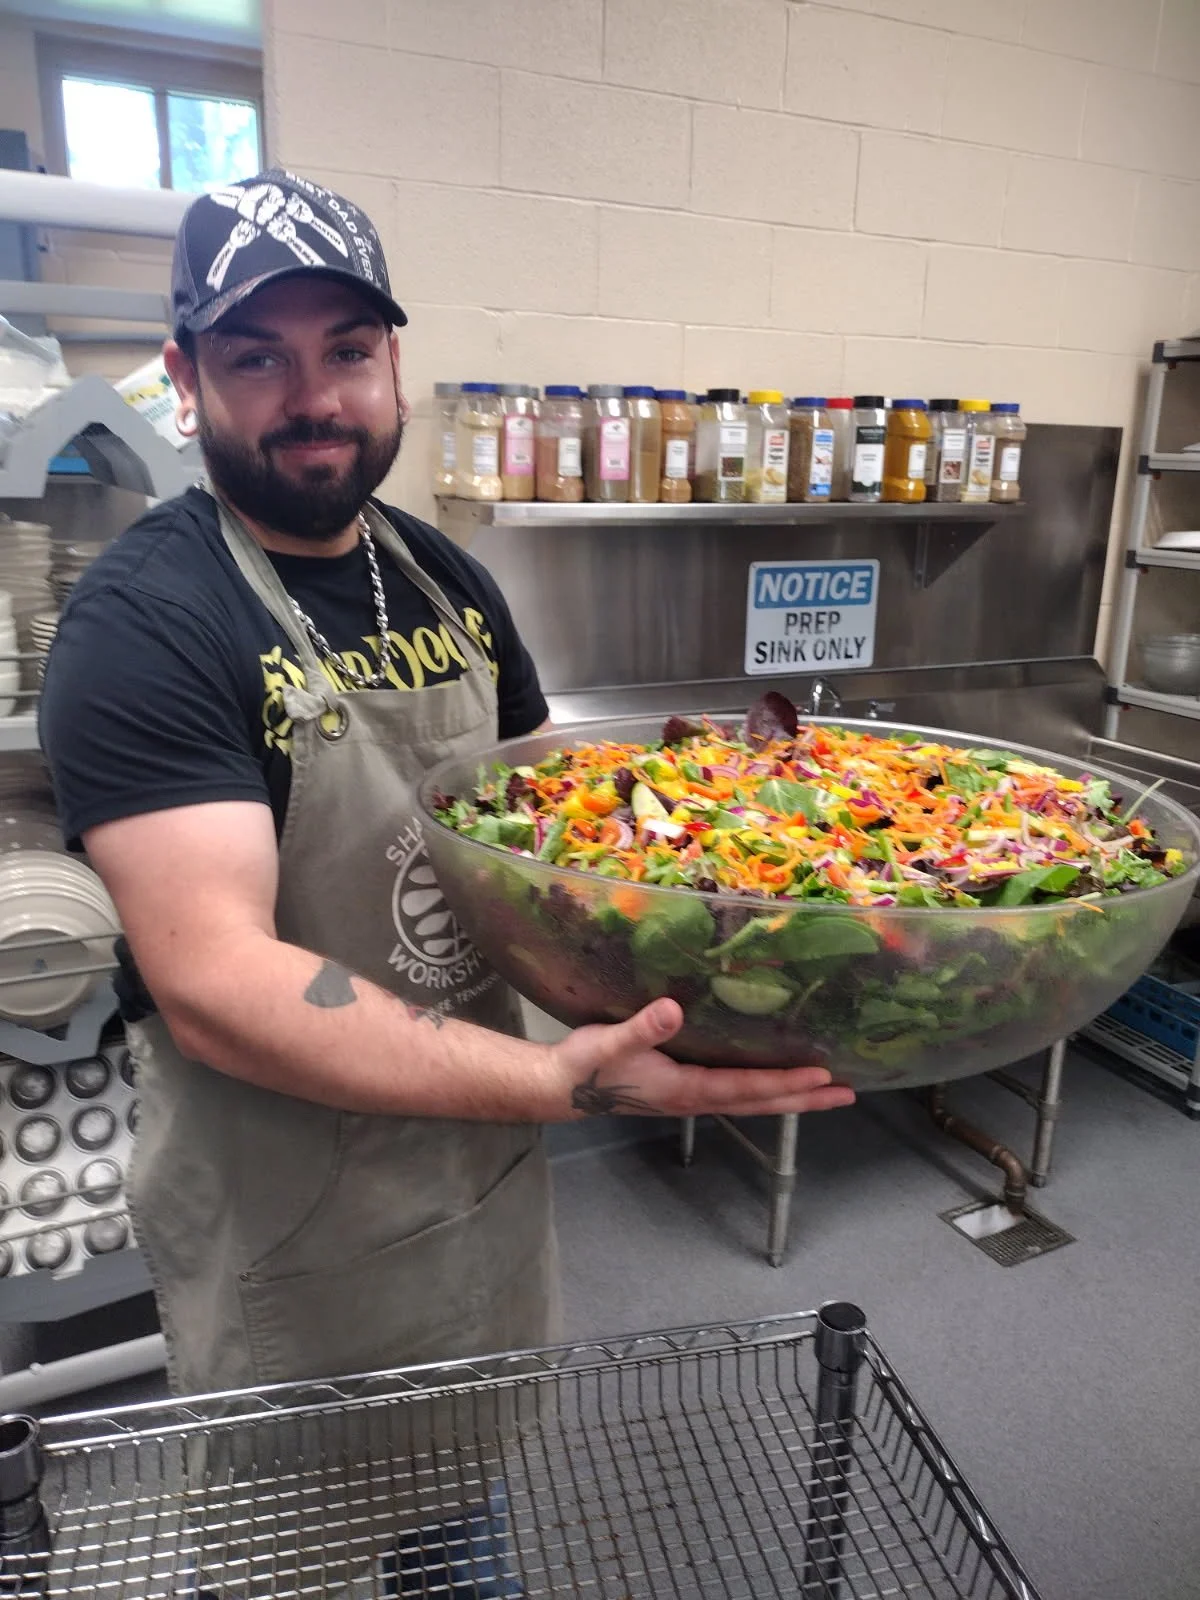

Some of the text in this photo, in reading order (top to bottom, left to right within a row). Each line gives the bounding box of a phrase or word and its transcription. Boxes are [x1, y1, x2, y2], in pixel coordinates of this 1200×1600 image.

[328, 199, 357, 233] DAD
[353, 236, 373, 281] EVER
[757, 571, 871, 603] NOTICE
[784, 611, 841, 636] PREP
[754, 636, 867, 665] SINK ONLY
